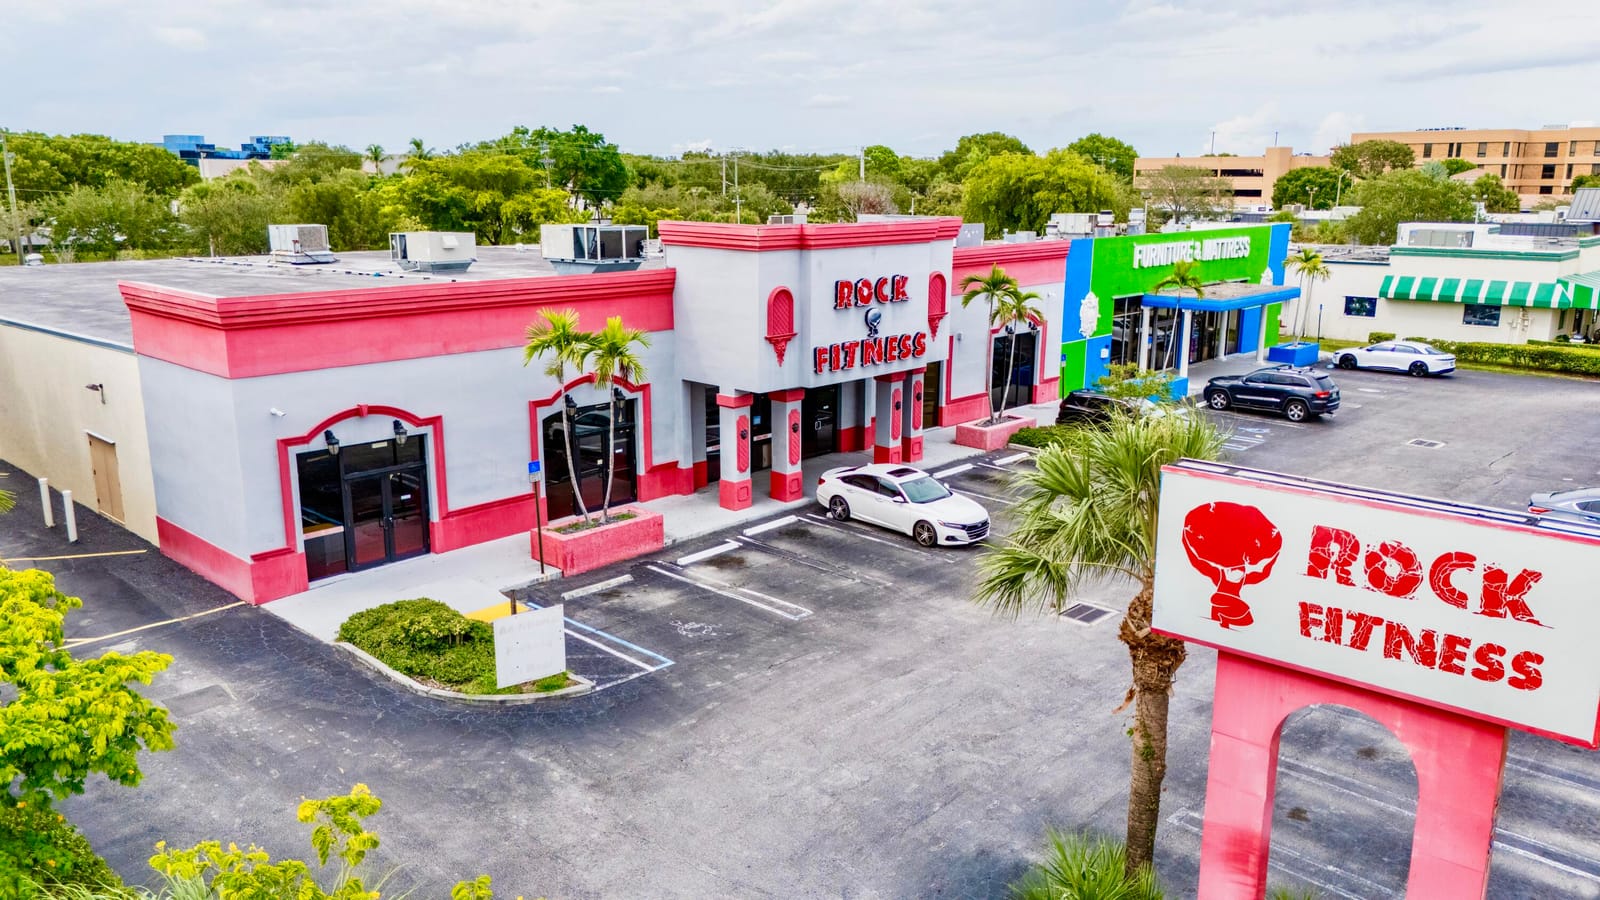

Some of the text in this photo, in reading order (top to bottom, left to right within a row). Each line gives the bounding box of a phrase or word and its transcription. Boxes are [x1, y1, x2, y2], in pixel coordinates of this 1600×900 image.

[1133, 241, 1194, 269] FURNITURE
[1202, 236, 1251, 261] MATTRESS
[834, 274, 910, 309] ROCK
[814, 332, 926, 374] FITNESS
[1300, 524, 1553, 629] ROCK
[1298, 601, 1544, 691] FITNESS
